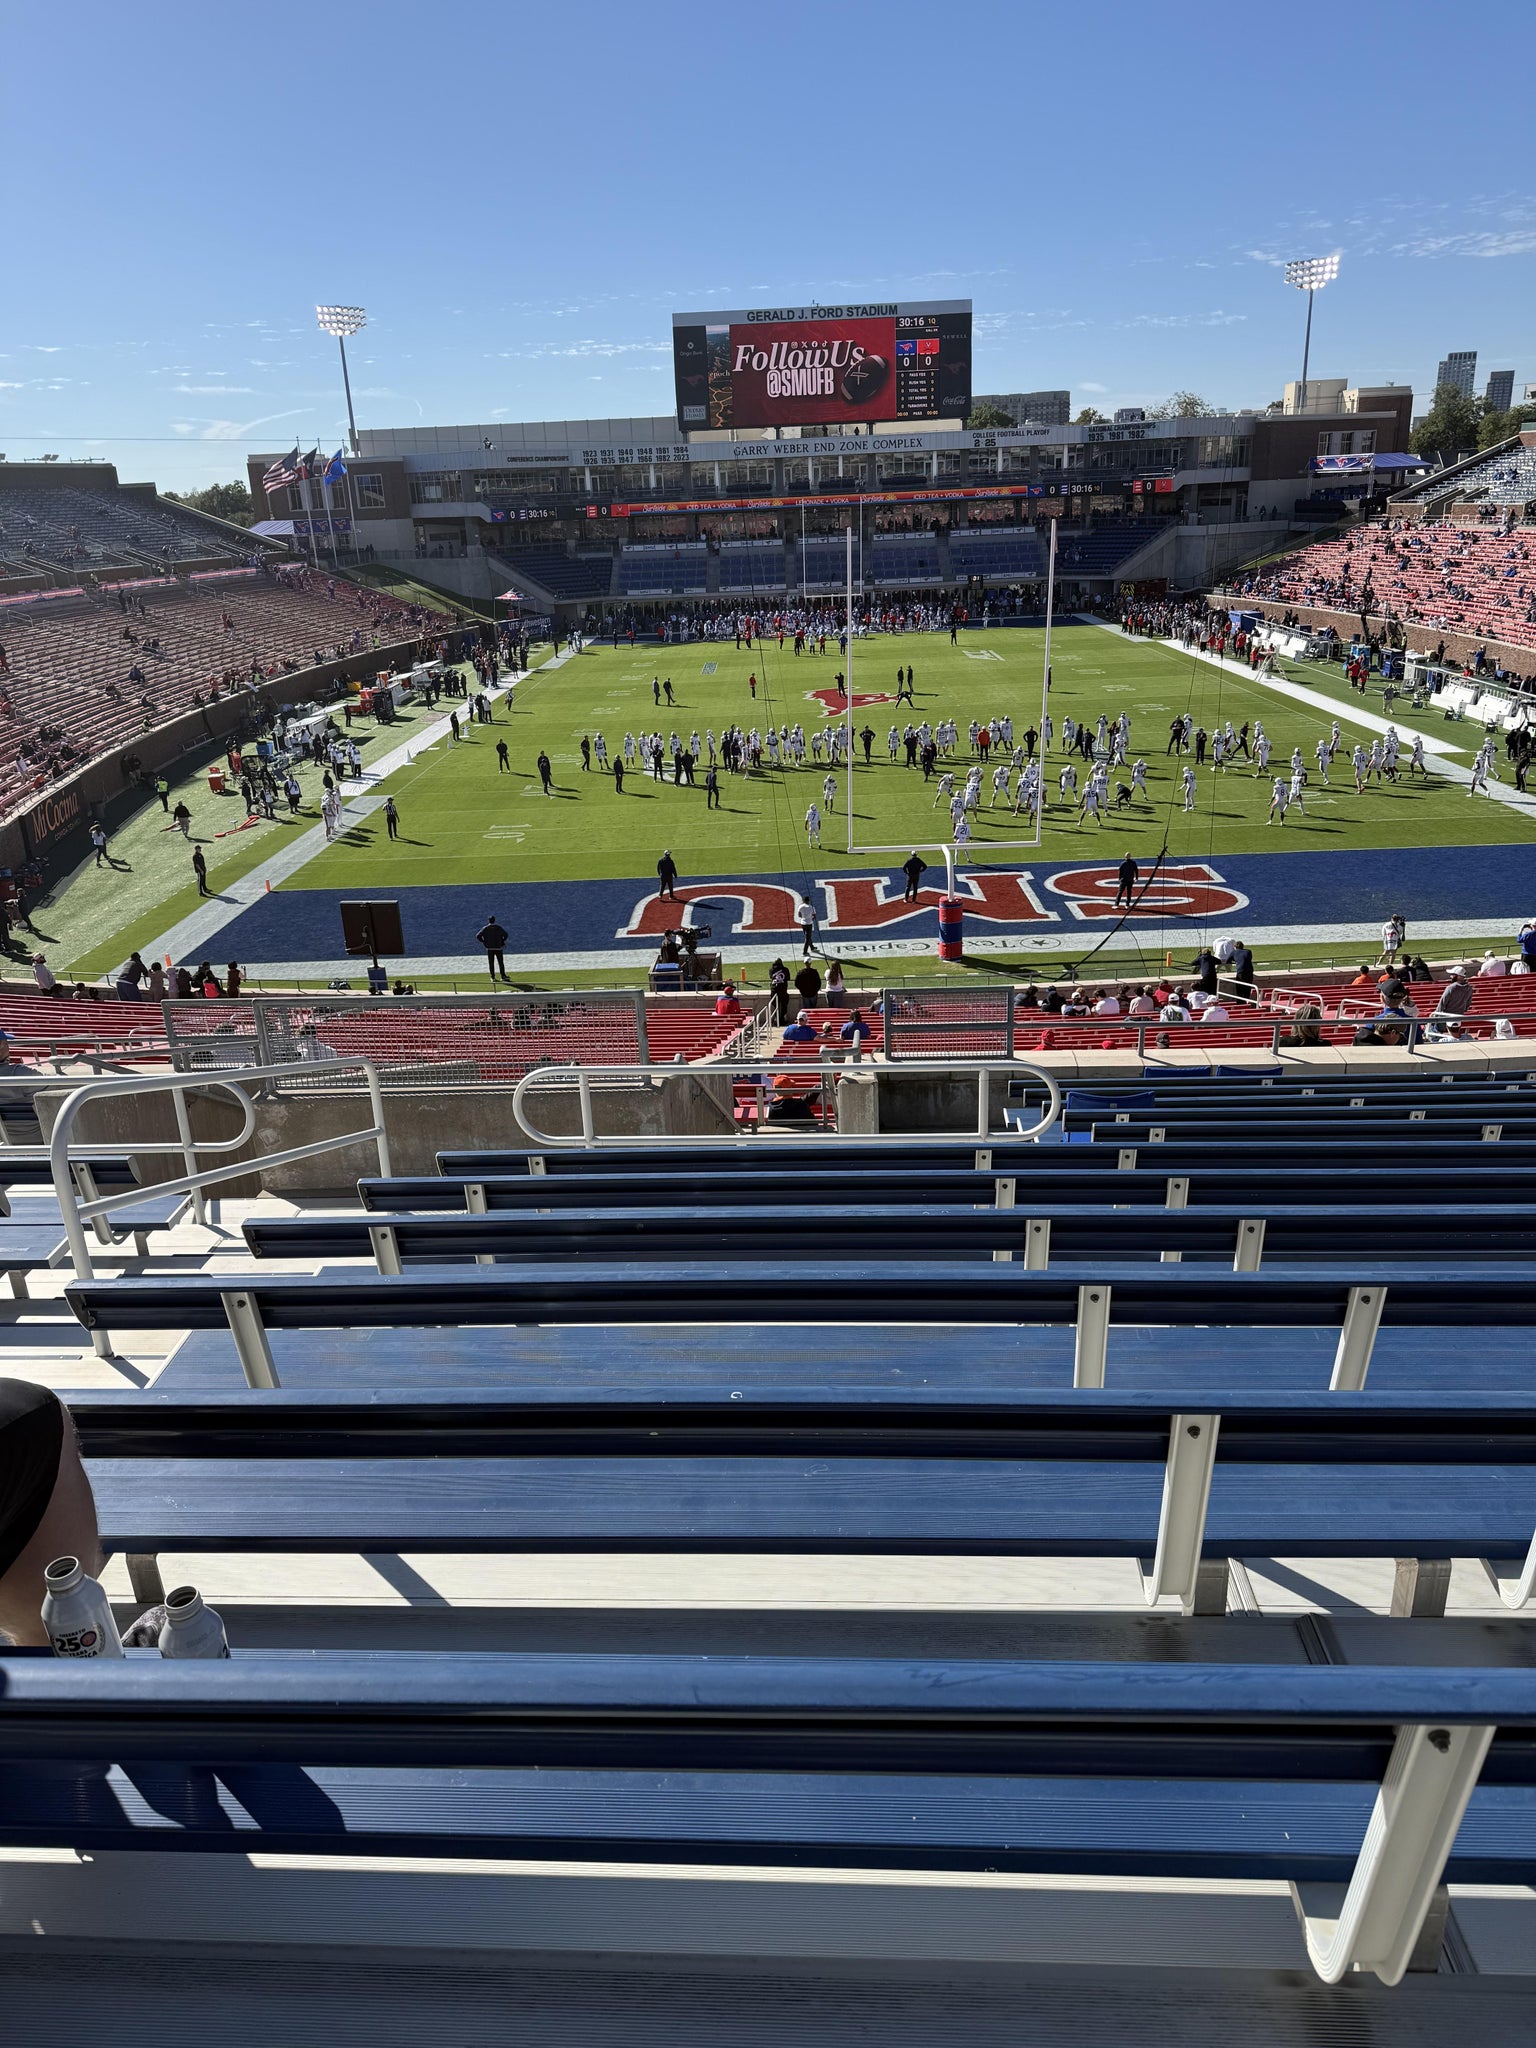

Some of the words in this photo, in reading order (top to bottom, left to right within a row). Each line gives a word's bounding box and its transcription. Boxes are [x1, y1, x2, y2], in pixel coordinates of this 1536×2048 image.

[747, 310, 795, 321] GERALD
[798, 310, 808, 320] J.
[811, 308, 843, 319] FORD
[846, 305, 898, 317] STADIUM
[899, 317, 924, 327] 30:16
[732, 342, 828, 372] Follow
[830, 340, 865, 367] Us
[926, 356, 932, 366] 0
[903, 357, 909, 367] 0
[767, 368, 834, 398] @SMUFB
[1026, 428, 1050, 436] PLAYOFF
[1088, 432, 1104, 441] 1935
[1109, 431, 1124, 440] 1981
[1128, 430, 1145, 439] 1982
[734, 445, 769, 456] GARRY
[773, 443, 809, 454] WEBER
[814, 442, 835, 452] END
[840, 440, 868, 451] ZONE
[872, 438, 923, 450] COMPLEX
[1050, 486, 1055, 494] 0
[1071, 484, 1093, 493] 30:16
[1146, 482, 1152, 490] 0
[528, 510, 548, 518] 30:16
[31, 804, 48, 844] Mi
[46, 790, 79, 831] Cocina
[960, 827, 968, 835] 21
[615, 864, 1250, 939] SMU
[836, 942, 930, 954] Capital
[55, 1631, 97, 1652] 250
